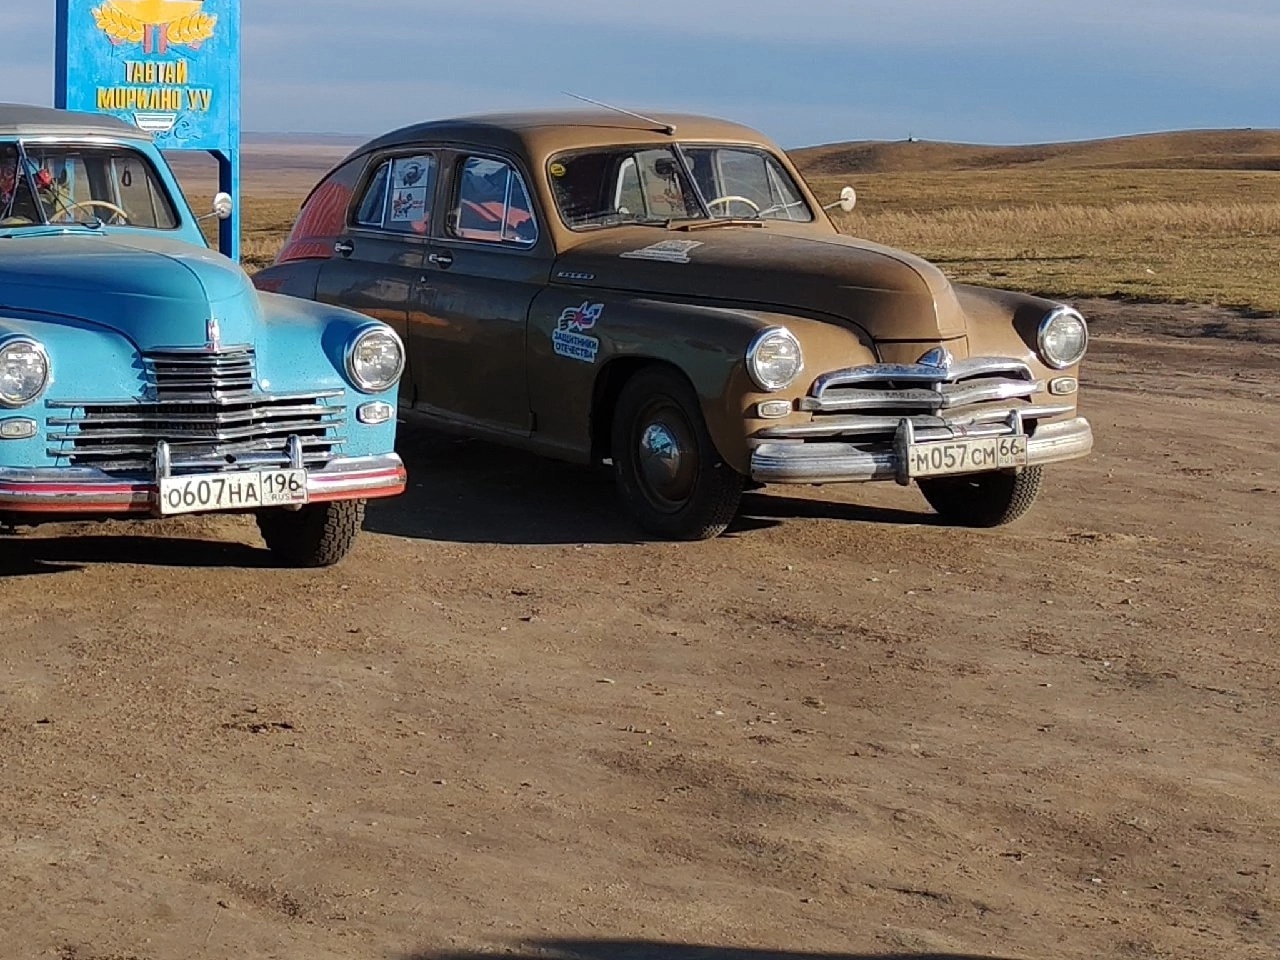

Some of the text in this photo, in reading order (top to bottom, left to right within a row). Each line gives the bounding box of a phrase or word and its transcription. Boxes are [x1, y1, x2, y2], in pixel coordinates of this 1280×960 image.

[123, 58, 189, 84] ТАВТАЙ
[96, 87, 182, 110] МОРИЛНО
[1000, 439, 1019, 456] 66
[263, 472, 300, 494] 196
[271, 494, 290, 502] RUS
